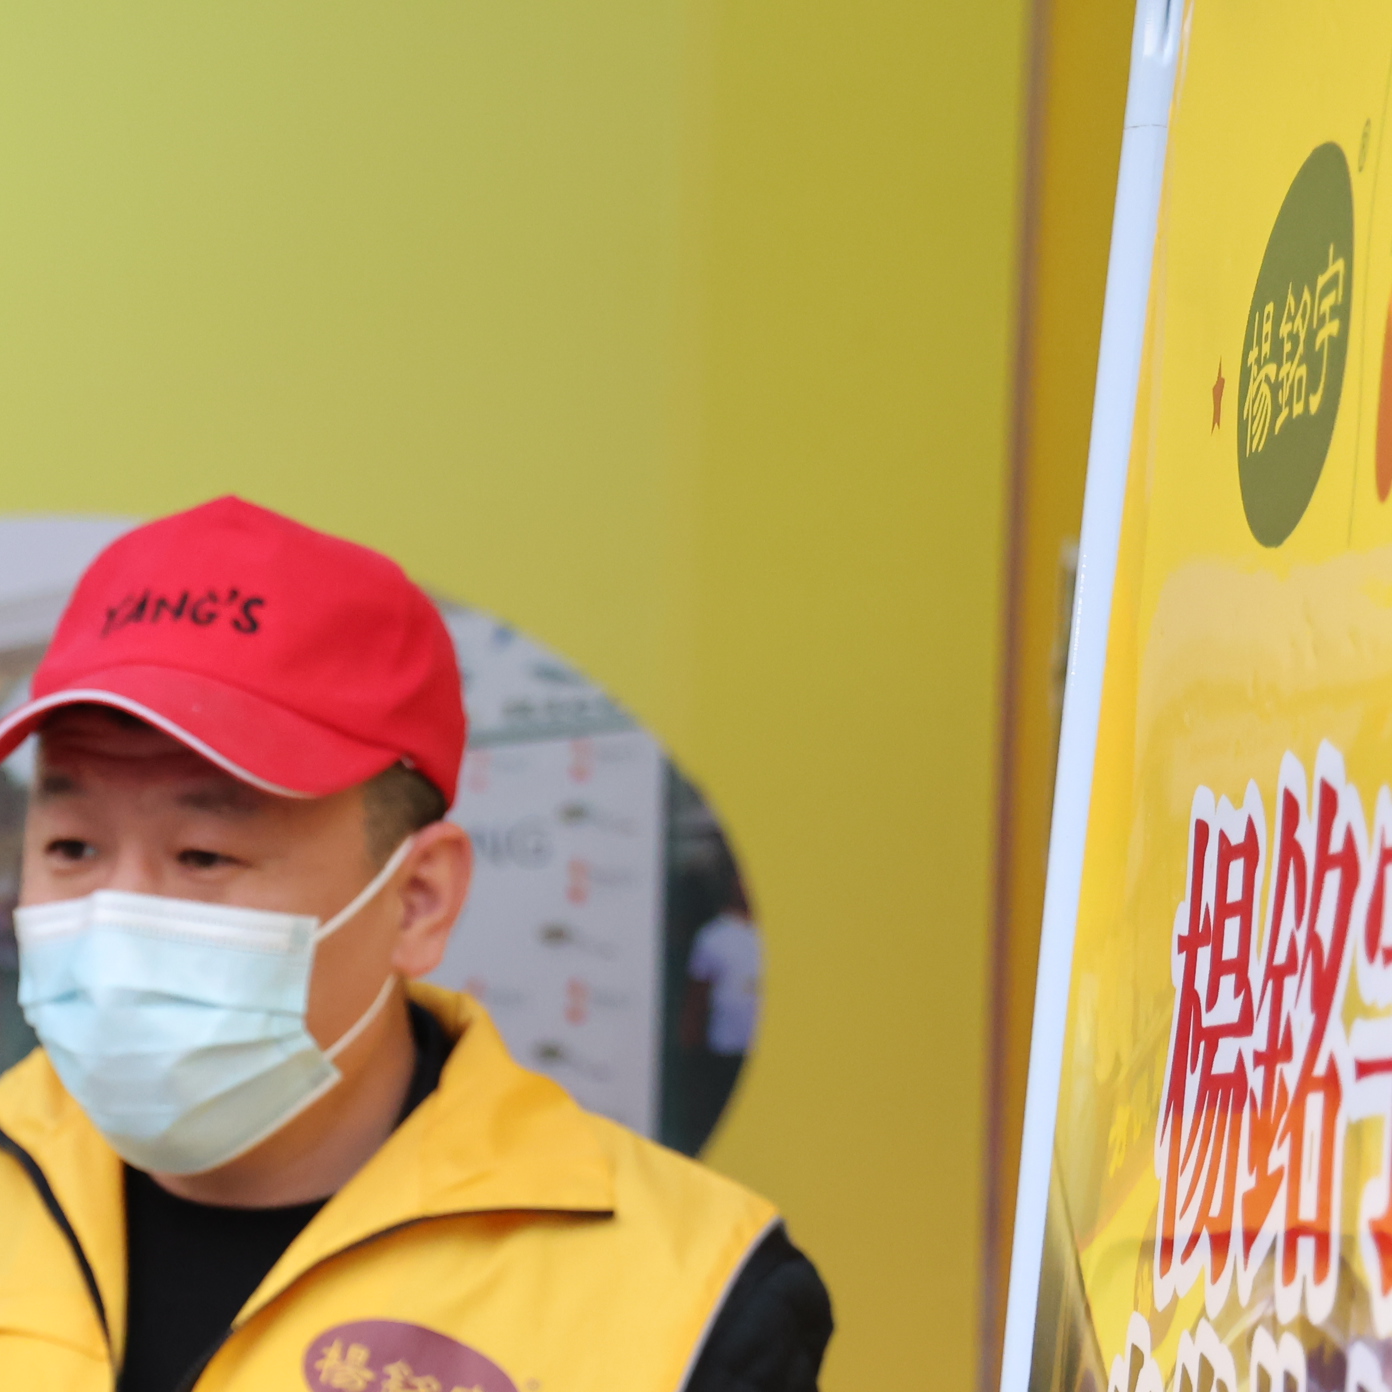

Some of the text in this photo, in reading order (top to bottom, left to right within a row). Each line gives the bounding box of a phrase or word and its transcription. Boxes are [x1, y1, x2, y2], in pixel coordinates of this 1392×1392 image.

[1244, 242, 1345, 457] 楊銘宇
[101, 586, 264, 637] YANG'S
